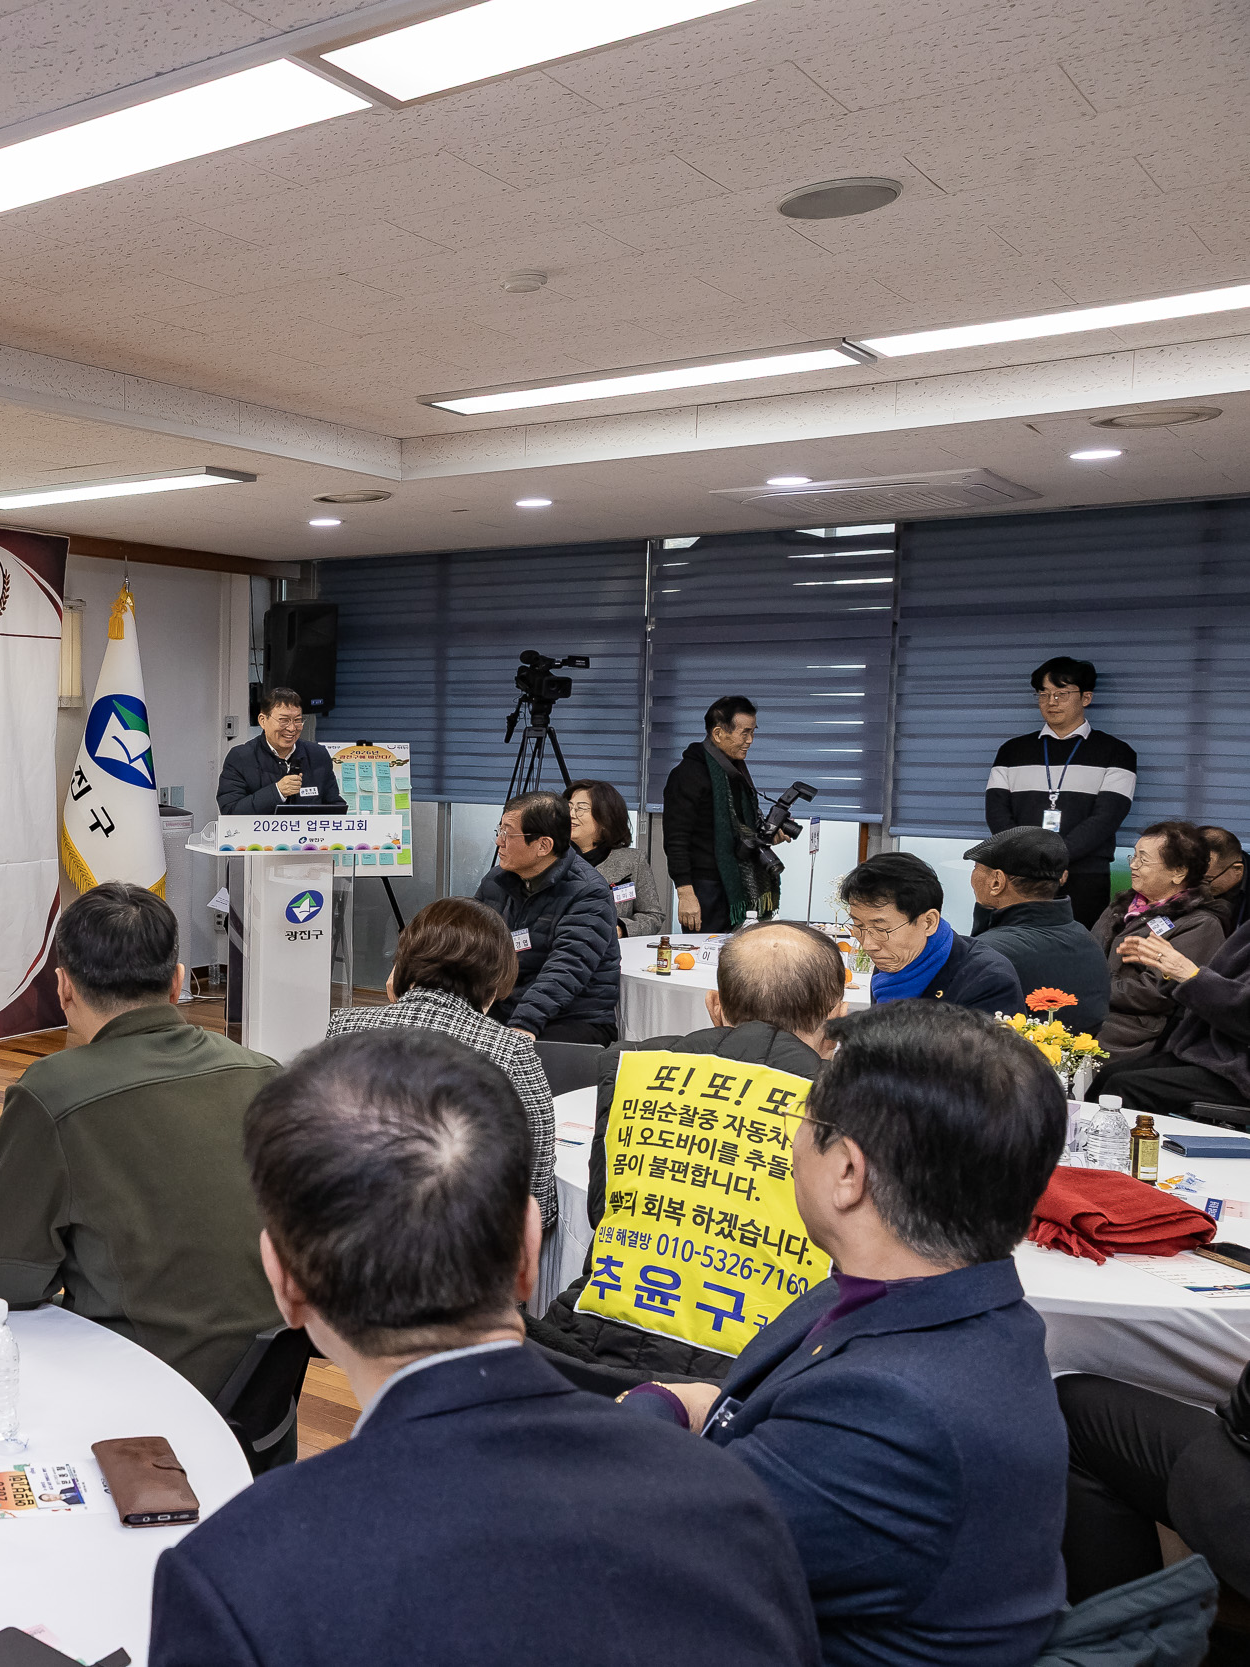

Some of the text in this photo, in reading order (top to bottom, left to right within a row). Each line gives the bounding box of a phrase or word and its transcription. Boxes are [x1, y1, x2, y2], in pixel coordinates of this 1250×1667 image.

[253, 819, 368, 832] 2026년 업무보고회
[285, 929, 324, 942] 광진구
[646, 1064, 696, 1097] 또!
[700, 1072, 753, 1106] 또!
[621, 1098, 794, 1151] 민원순찰중 자동차
[613, 1153, 761, 1202] 몸이 불편합니다.
[617, 1126, 795, 1181] 내 오도바이를 추돌
[641, 1193, 686, 1227] 회복
[692, 1204, 813, 1266] 하겠습니다.
[599, 1226, 809, 1296] 민원 해결방 010-5326-7160
